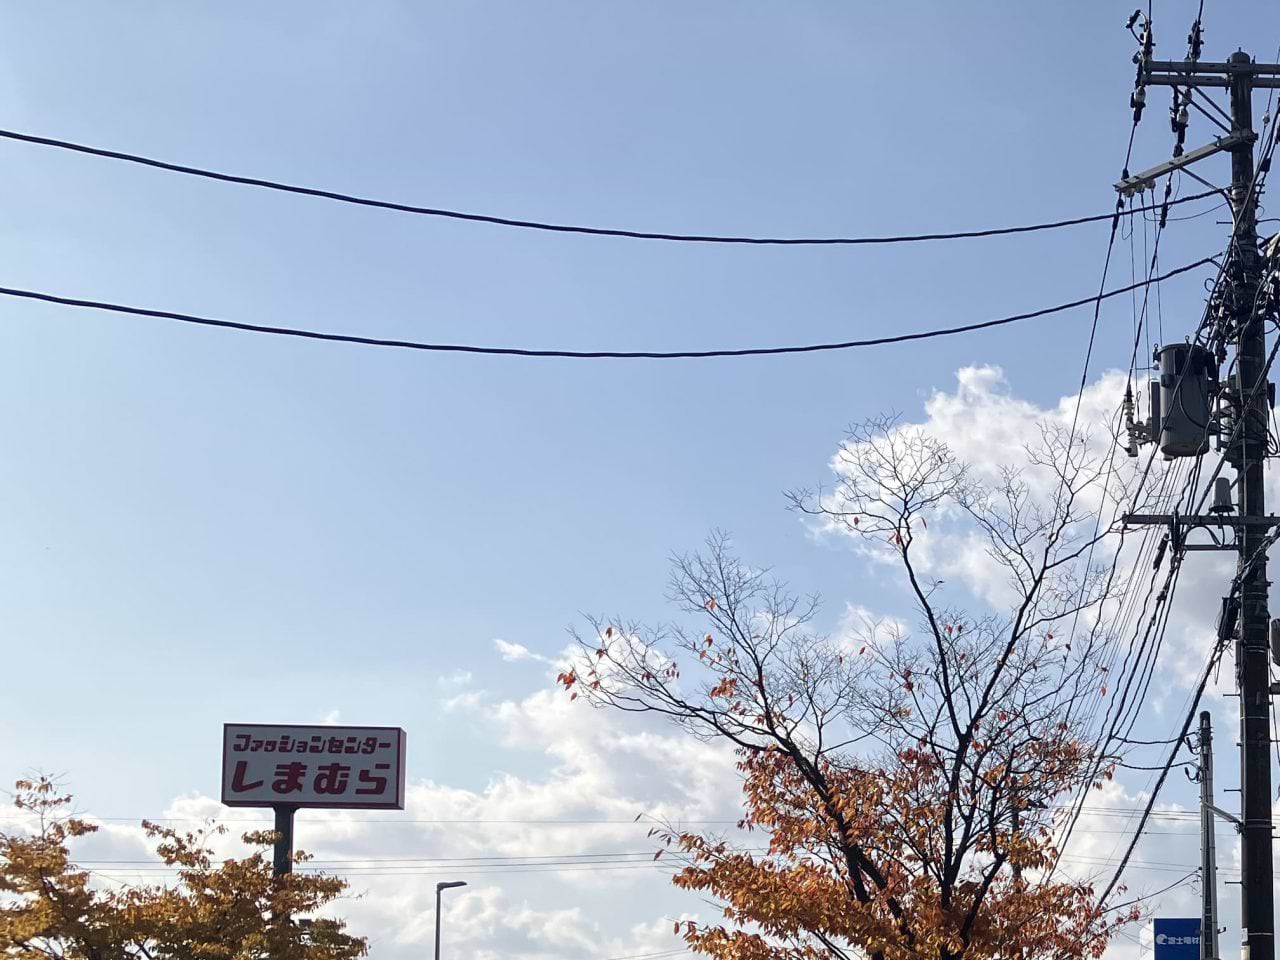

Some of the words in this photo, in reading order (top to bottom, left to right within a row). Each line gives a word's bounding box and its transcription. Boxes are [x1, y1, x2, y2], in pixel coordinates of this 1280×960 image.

[233, 734, 391, 754] ファッションセンター
[231, 760, 391, 795] しまむら
